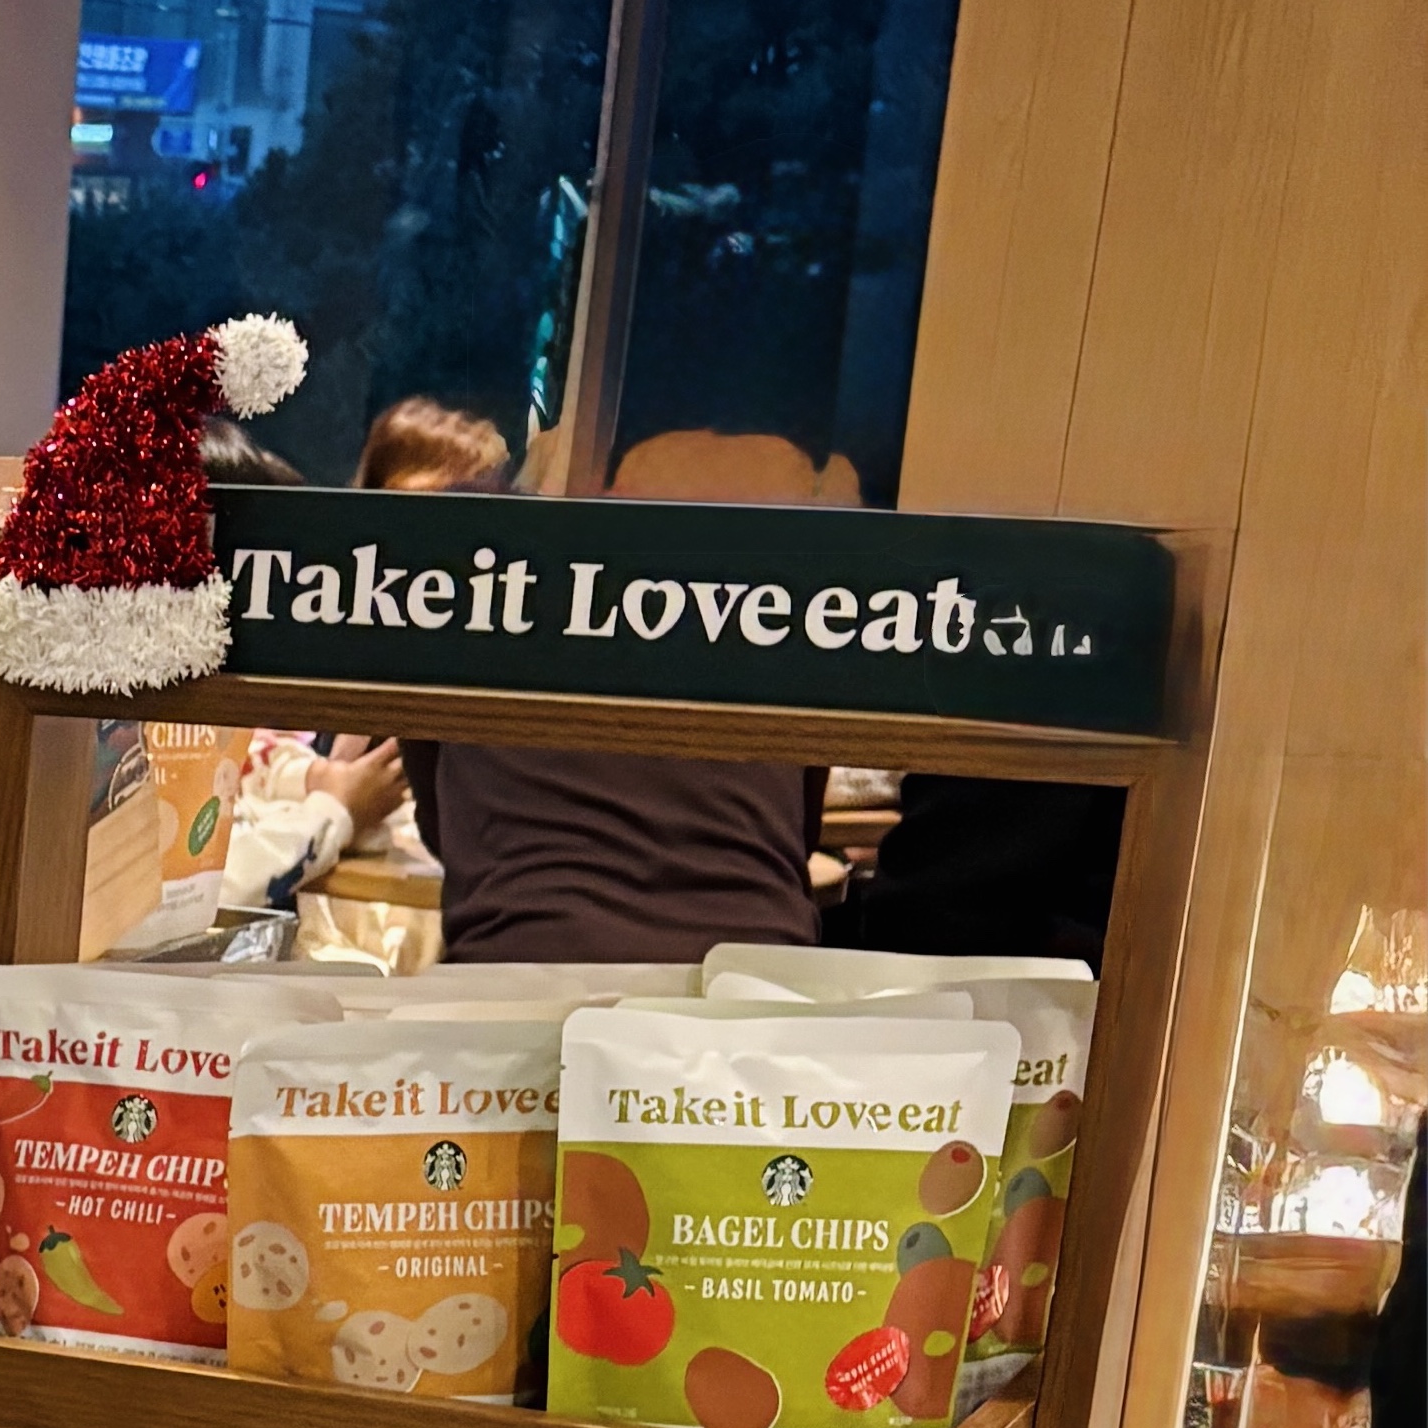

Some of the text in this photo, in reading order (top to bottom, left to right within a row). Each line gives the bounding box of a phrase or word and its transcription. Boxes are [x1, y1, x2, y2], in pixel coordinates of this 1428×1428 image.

[151, 722, 217, 749] CHIPS
[14, 1139, 144, 1180] TEMPEH
[146, 1154, 227, 1189] CHIP
[318, 1200, 459, 1233] TEMPEH
[672, 1213, 890, 1252] BAGEL CHIPS
[395, 1255, 489, 1278] ORIGINAL
